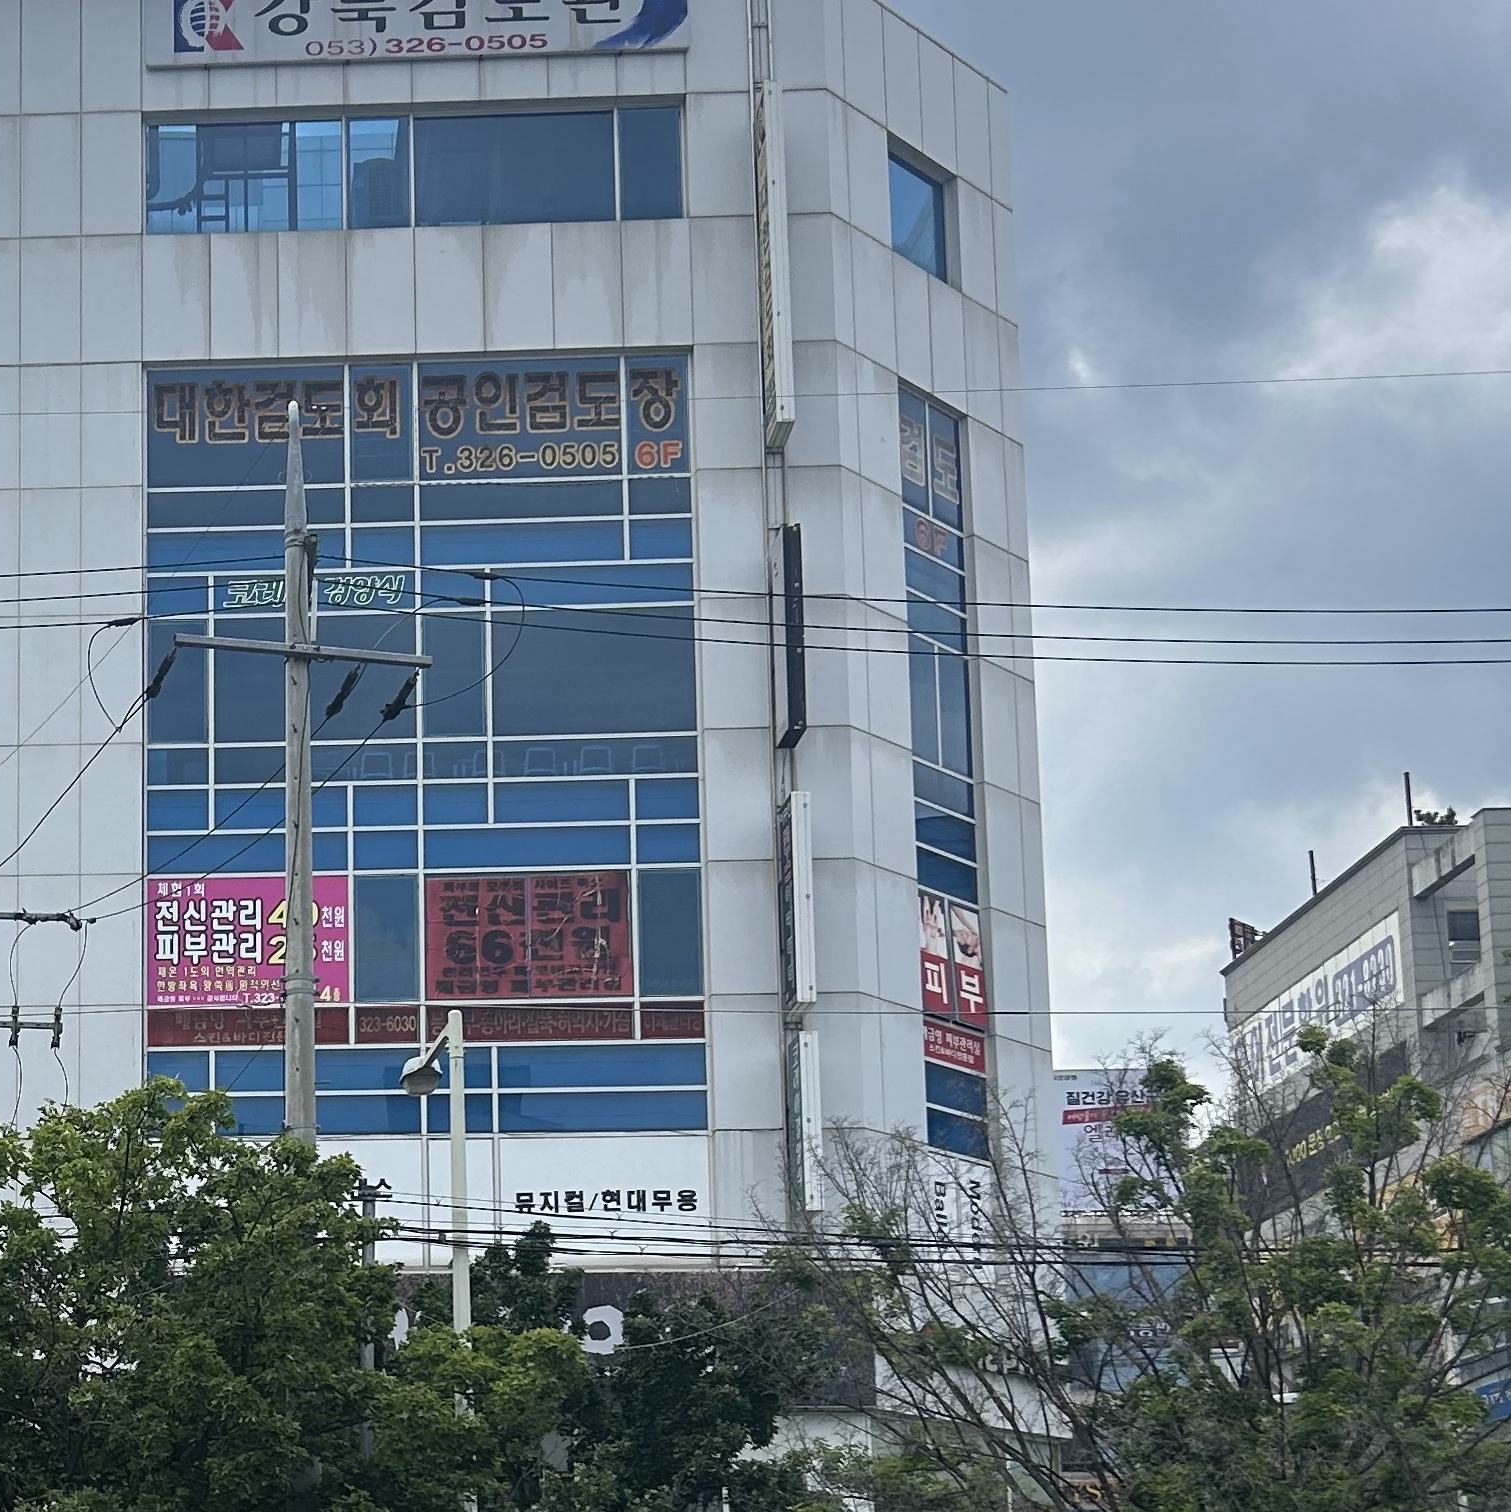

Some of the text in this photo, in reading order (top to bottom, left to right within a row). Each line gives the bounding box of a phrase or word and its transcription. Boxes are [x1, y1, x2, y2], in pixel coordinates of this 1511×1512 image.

[152, 367, 681, 444] 대한검도회 공인검도장
[635, 441, 682, 469] 6F
[155, 898, 263, 932] 전신관리
[155, 931, 263, 965] 피부관리
[924, 961, 984, 1013] 피부
[359, 1014, 417, 1033] 323-6030
[514, 1189, 698, 1214] 뮤지컬/현대무용
